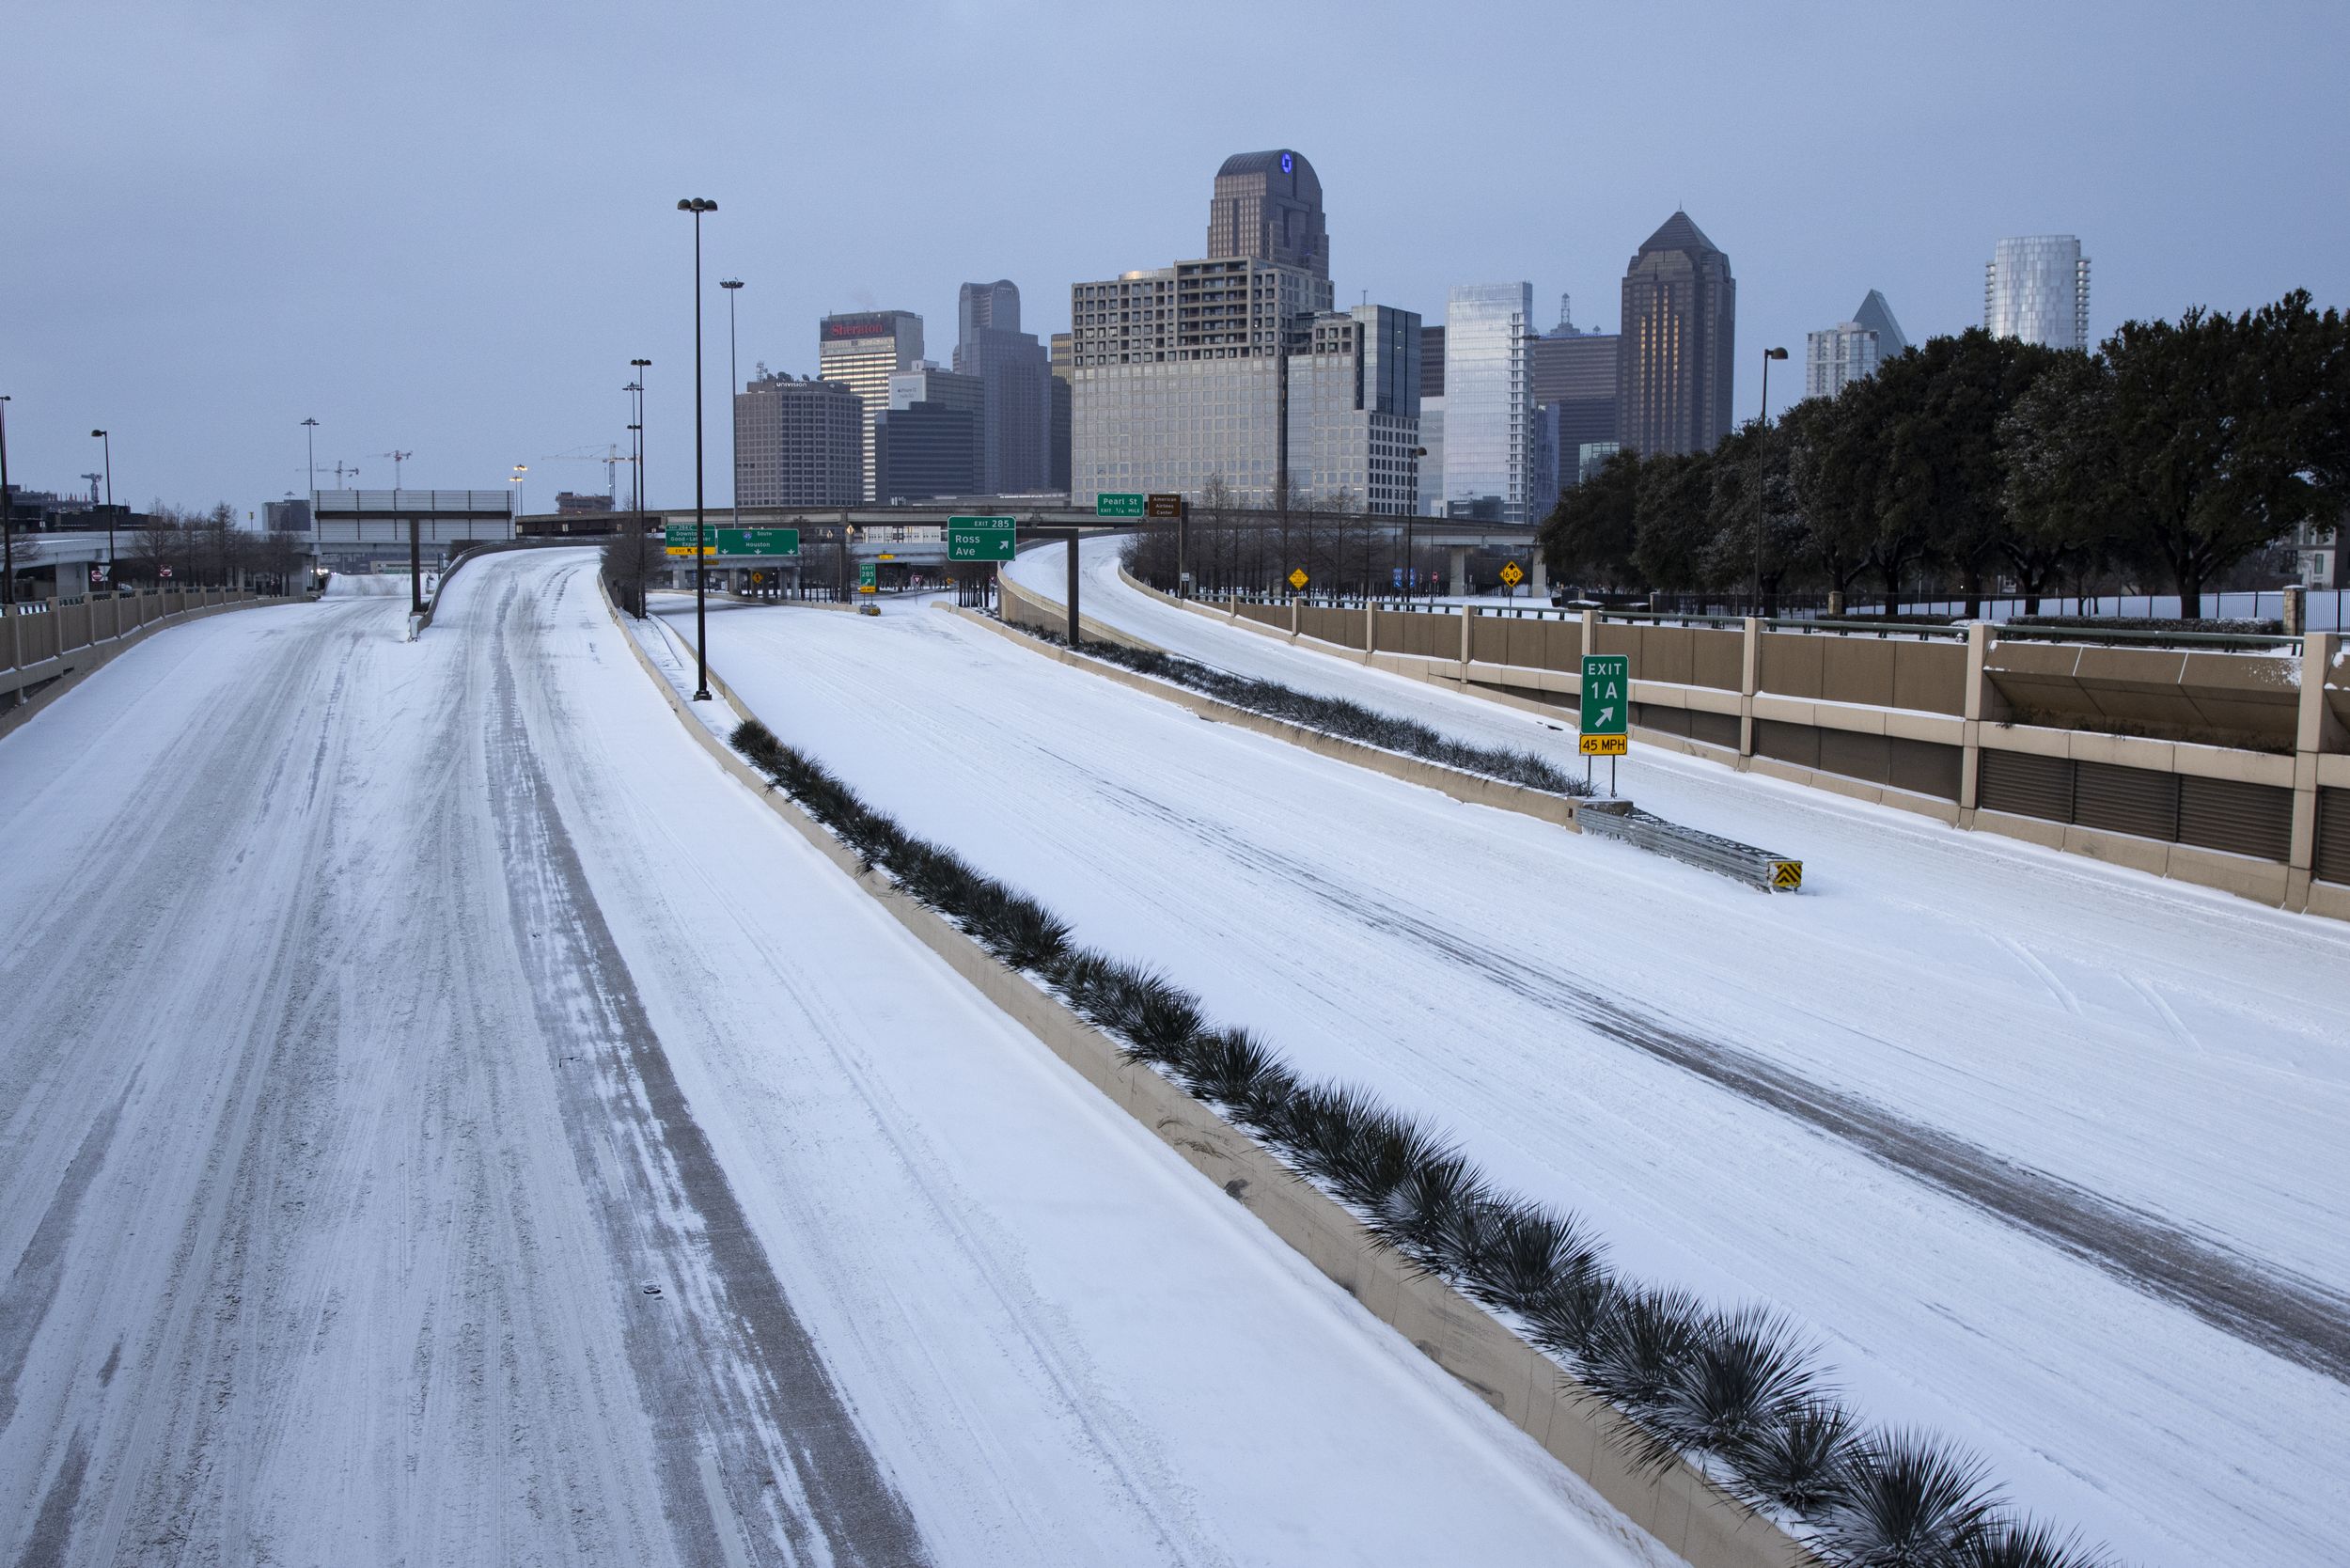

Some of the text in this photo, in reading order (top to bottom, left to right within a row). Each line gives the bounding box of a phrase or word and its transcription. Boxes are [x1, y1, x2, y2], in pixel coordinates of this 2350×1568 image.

[831, 323, 884, 336] Sheraton
[992, 520, 1010, 528] 285
[955, 534, 980, 543] Ross
[955, 546, 976, 557] Ave
[1588, 663, 1622, 676] EXIT
[1591, 682, 1618, 699] 1A
[1582, 739, 1625, 751] 45 MPH
